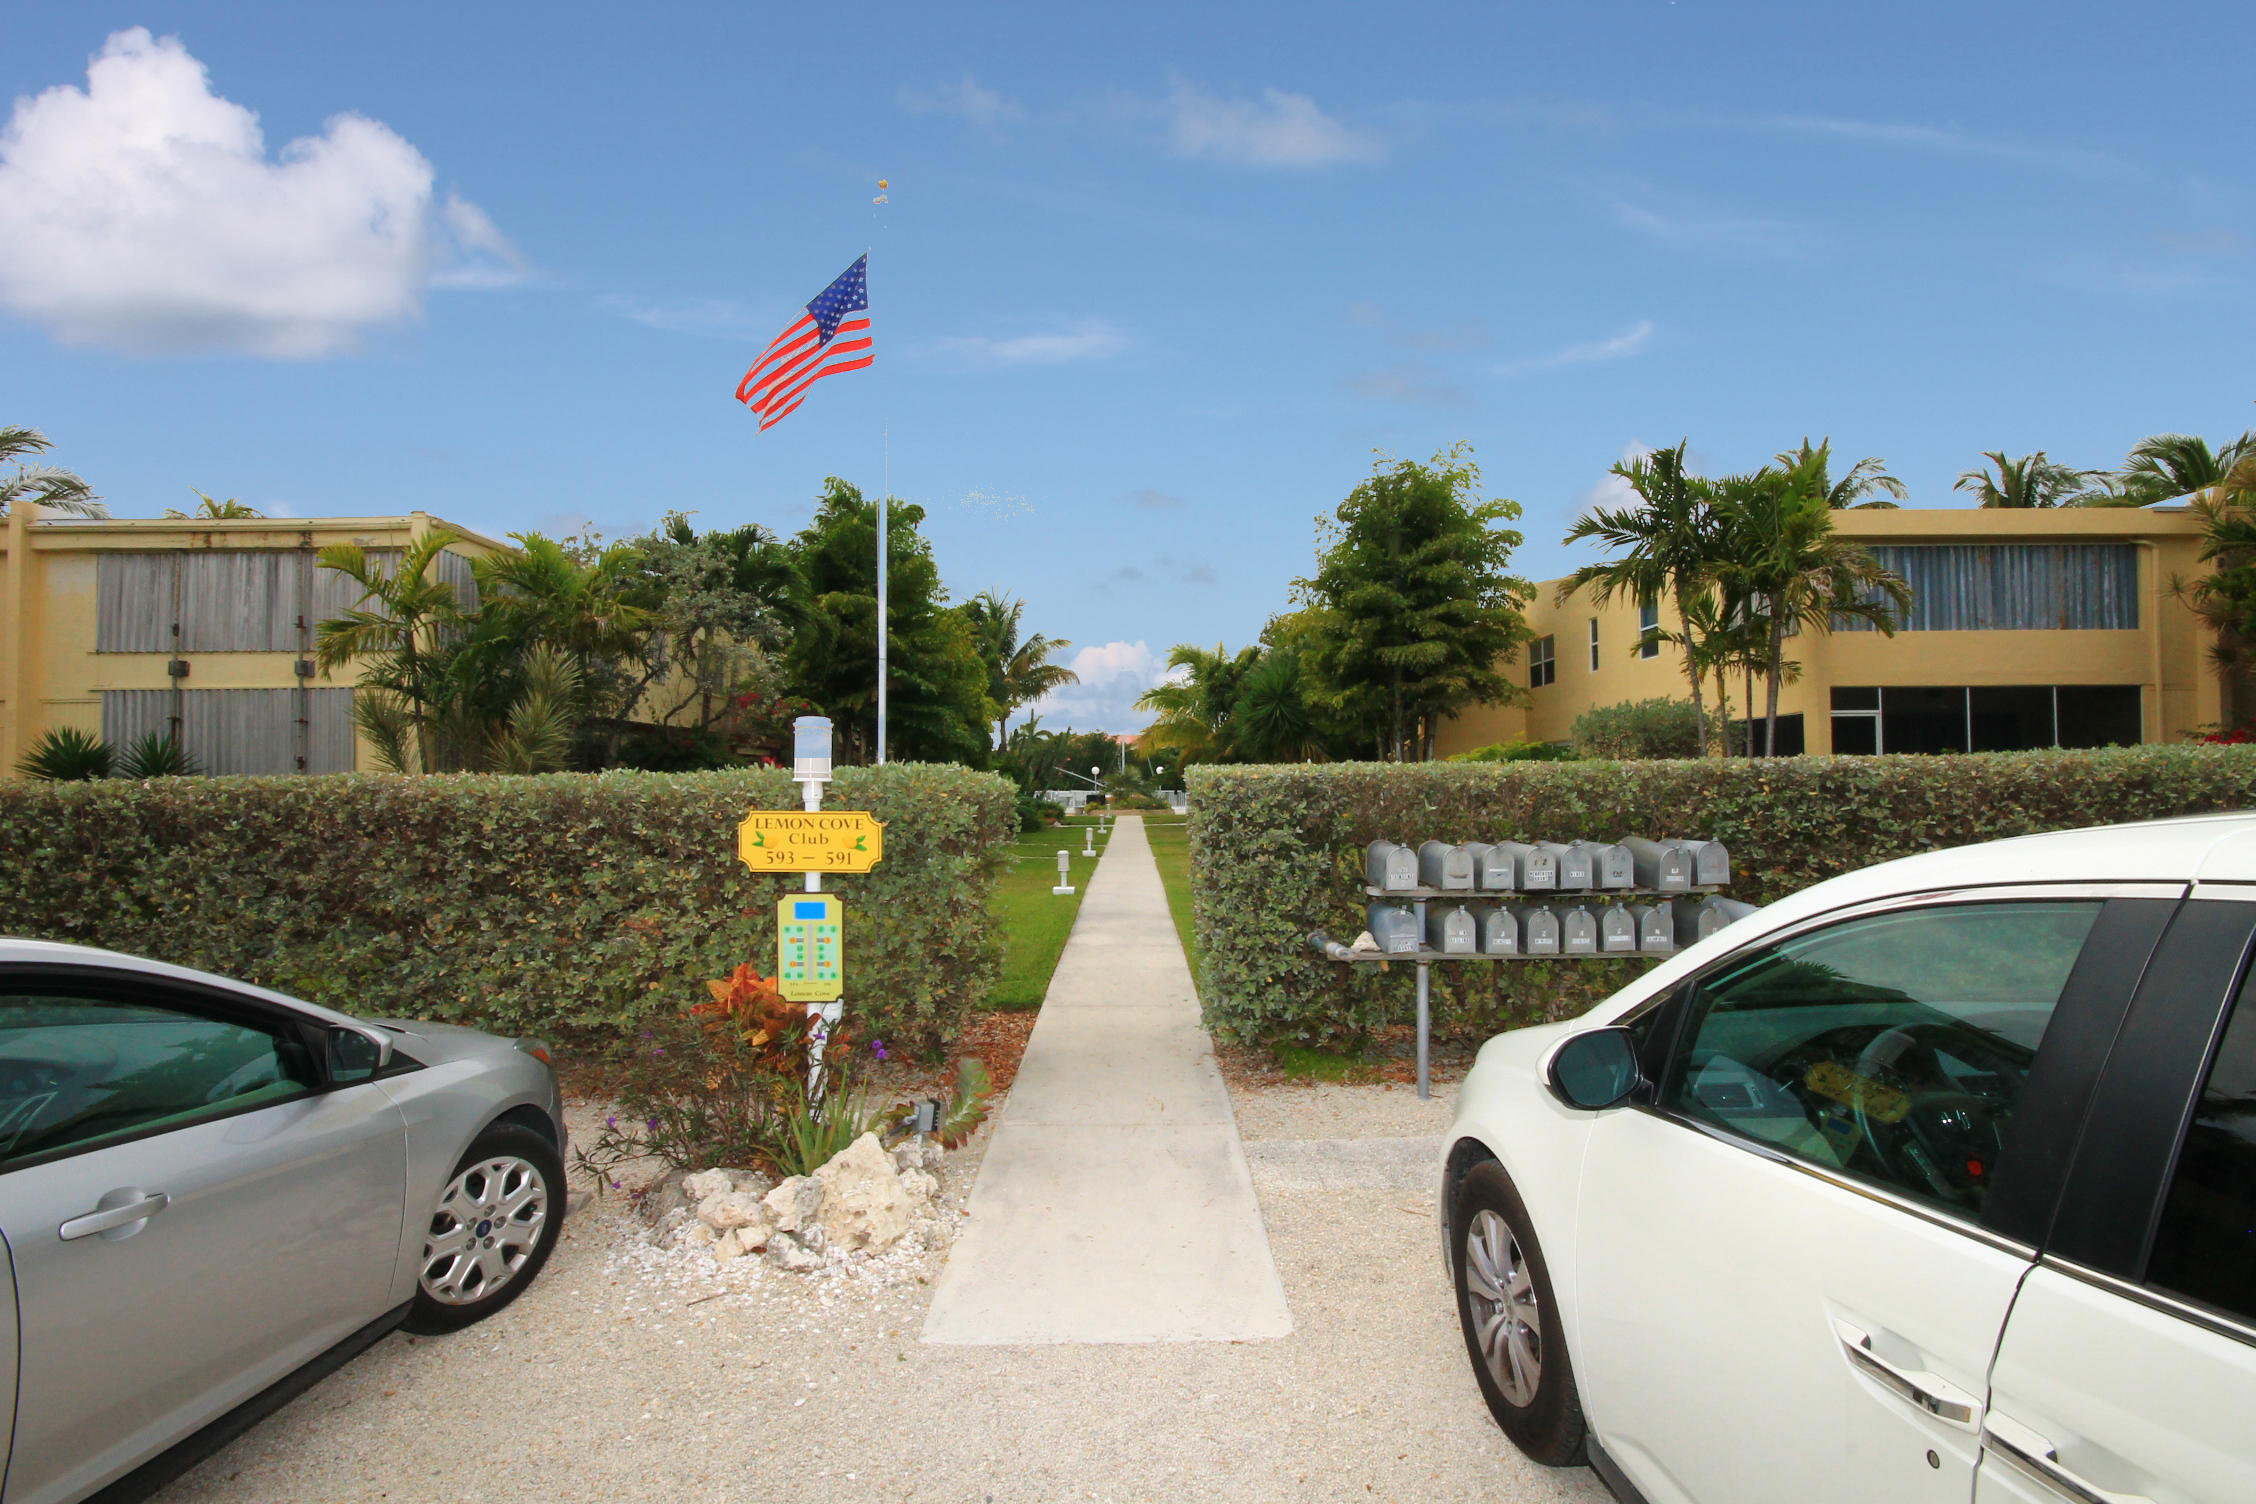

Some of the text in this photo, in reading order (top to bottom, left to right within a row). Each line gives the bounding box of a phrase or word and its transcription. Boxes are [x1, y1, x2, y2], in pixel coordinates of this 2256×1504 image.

[754, 817, 865, 830] LEMON COVE
[788, 832, 829, 845] Club
[765, 850, 795, 865] 593
[825, 851, 852, 865] 591
